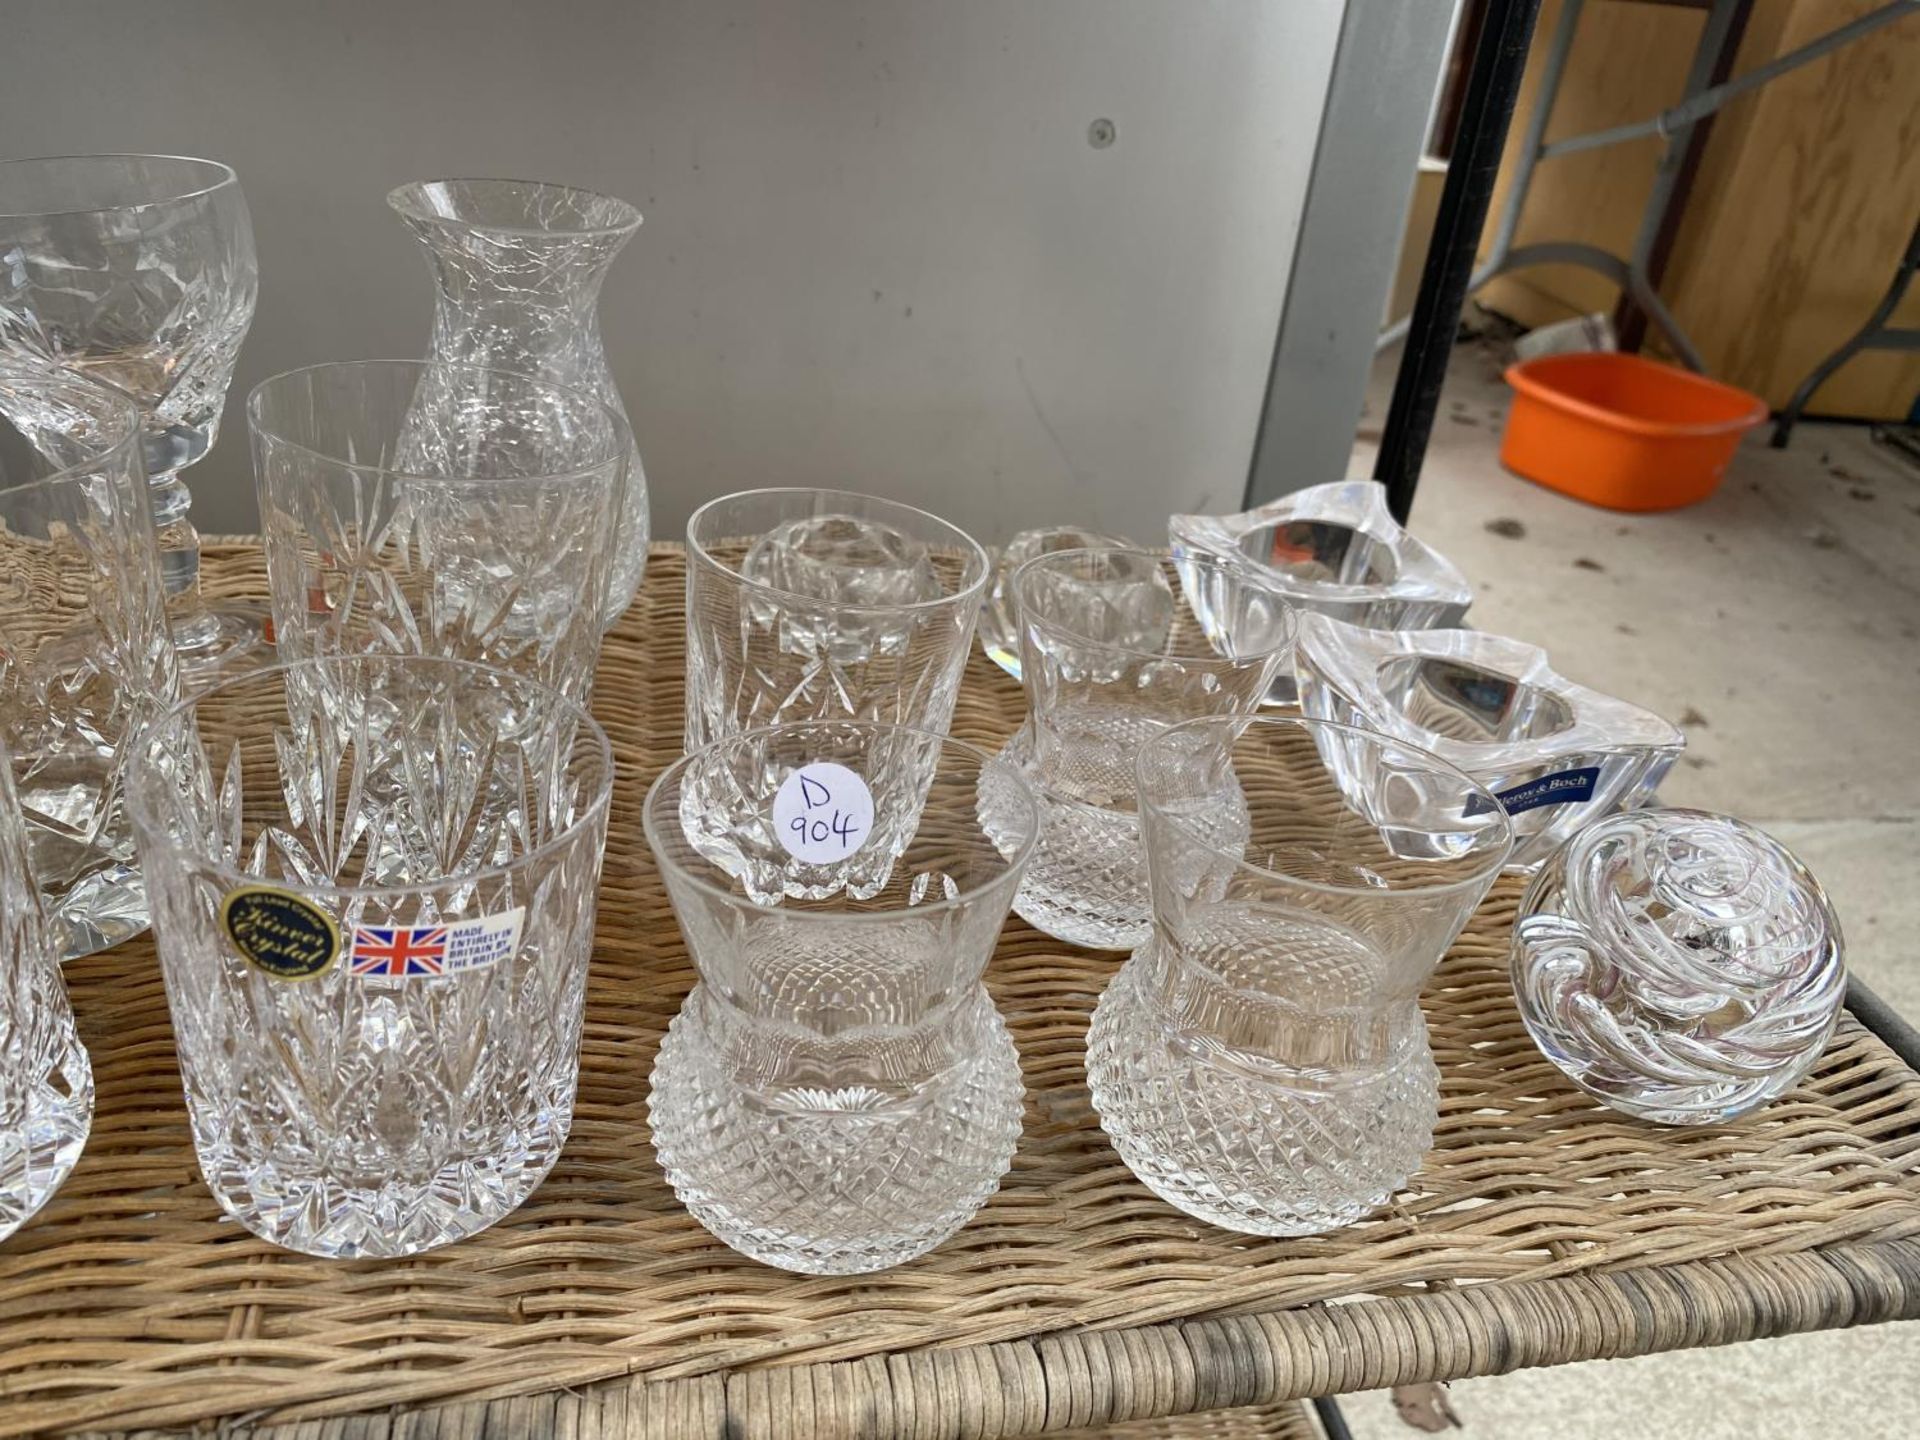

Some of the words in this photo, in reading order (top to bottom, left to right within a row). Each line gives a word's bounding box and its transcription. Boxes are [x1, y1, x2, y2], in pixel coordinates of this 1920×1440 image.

[800, 774, 831, 809] D
[1537, 783, 1548, 794] &
[1549, 775, 1588, 790] Boch
[790, 809, 859, 848] 904
[451, 932, 500, 949] ENTIRELY
[501, 928, 513, 938] IN
[453, 926, 483, 938] MADE
[234, 922, 325, 964] Crystal
[449, 944, 493, 959] BRITAIN
[496, 940, 507, 950] BY
[449, 958, 467, 969] THE
